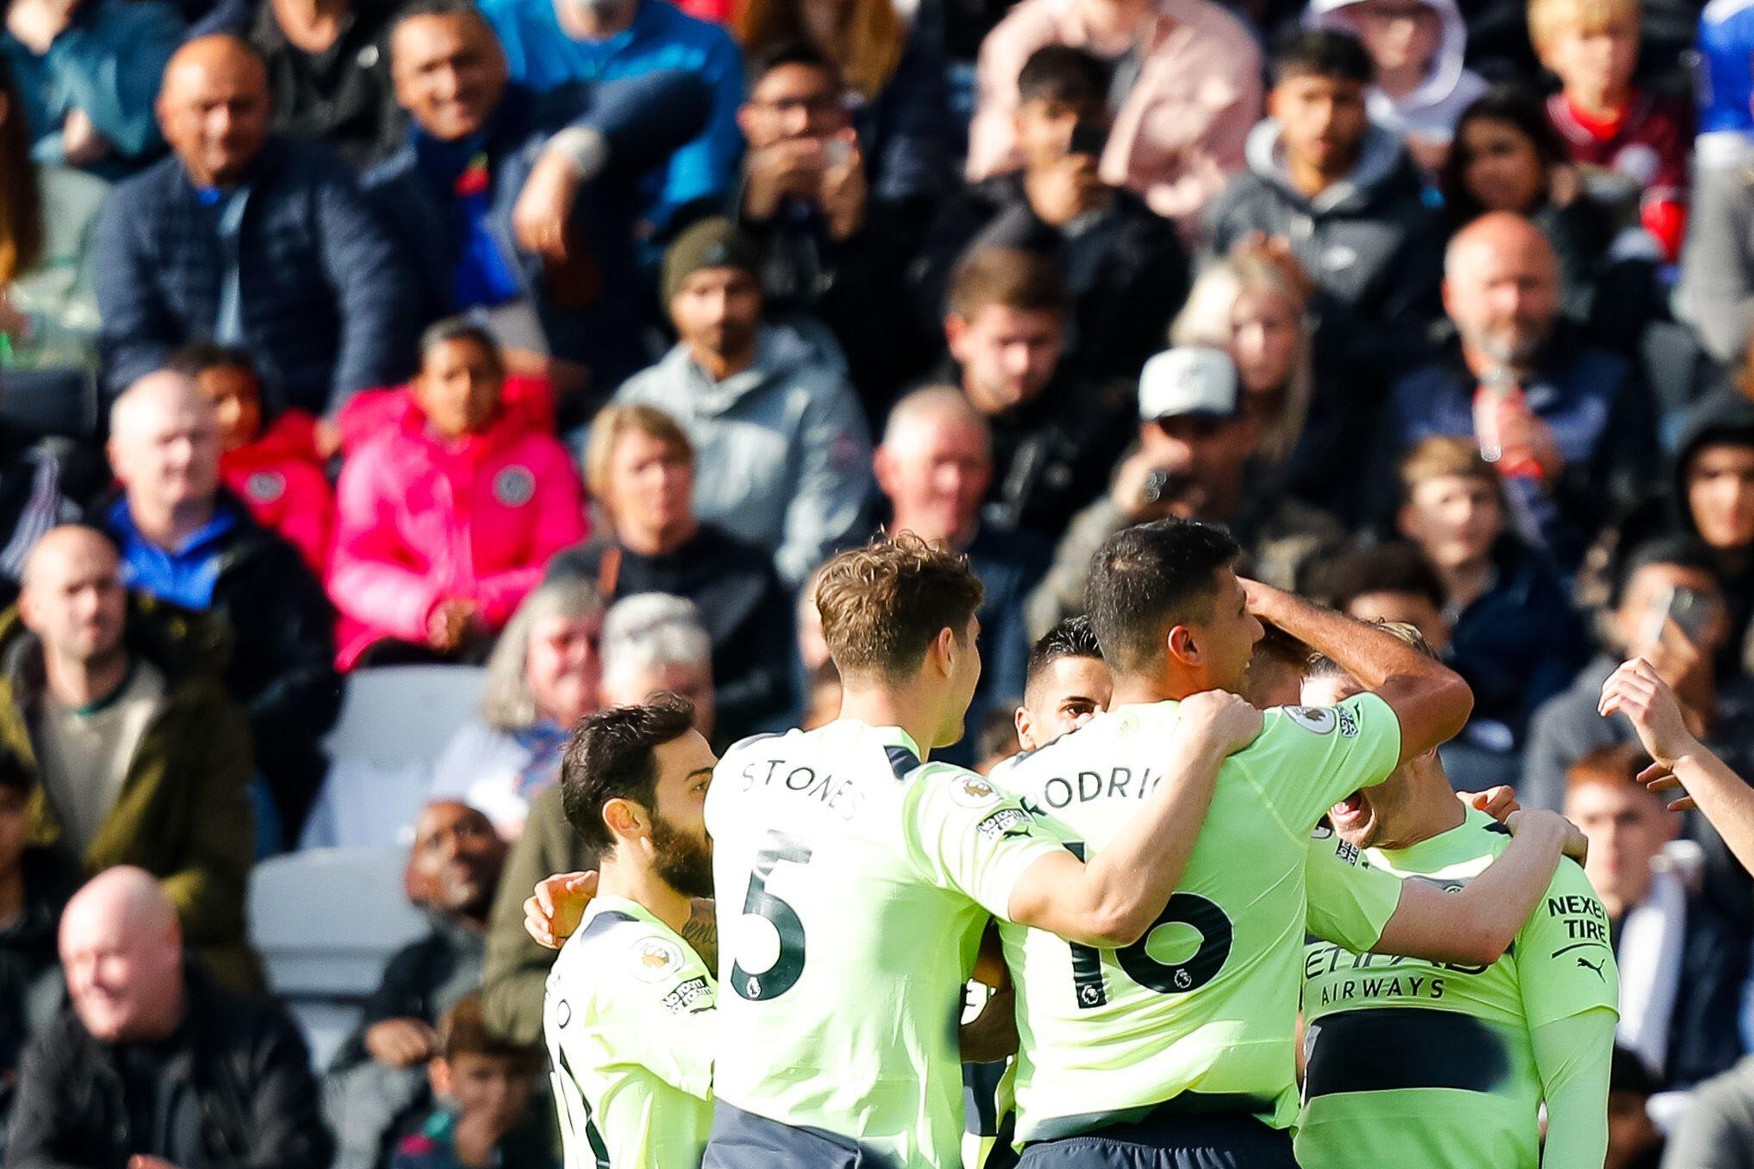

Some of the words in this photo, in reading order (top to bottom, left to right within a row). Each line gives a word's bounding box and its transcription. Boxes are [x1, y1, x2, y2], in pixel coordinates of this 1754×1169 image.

[742, 759, 866, 822] STONES
[731, 828, 813, 1001] 5
[1548, 895, 1606, 920] NEXE
[1563, 919, 1607, 944] TIRE
[1321, 976, 1445, 1006] AIRWAYS
